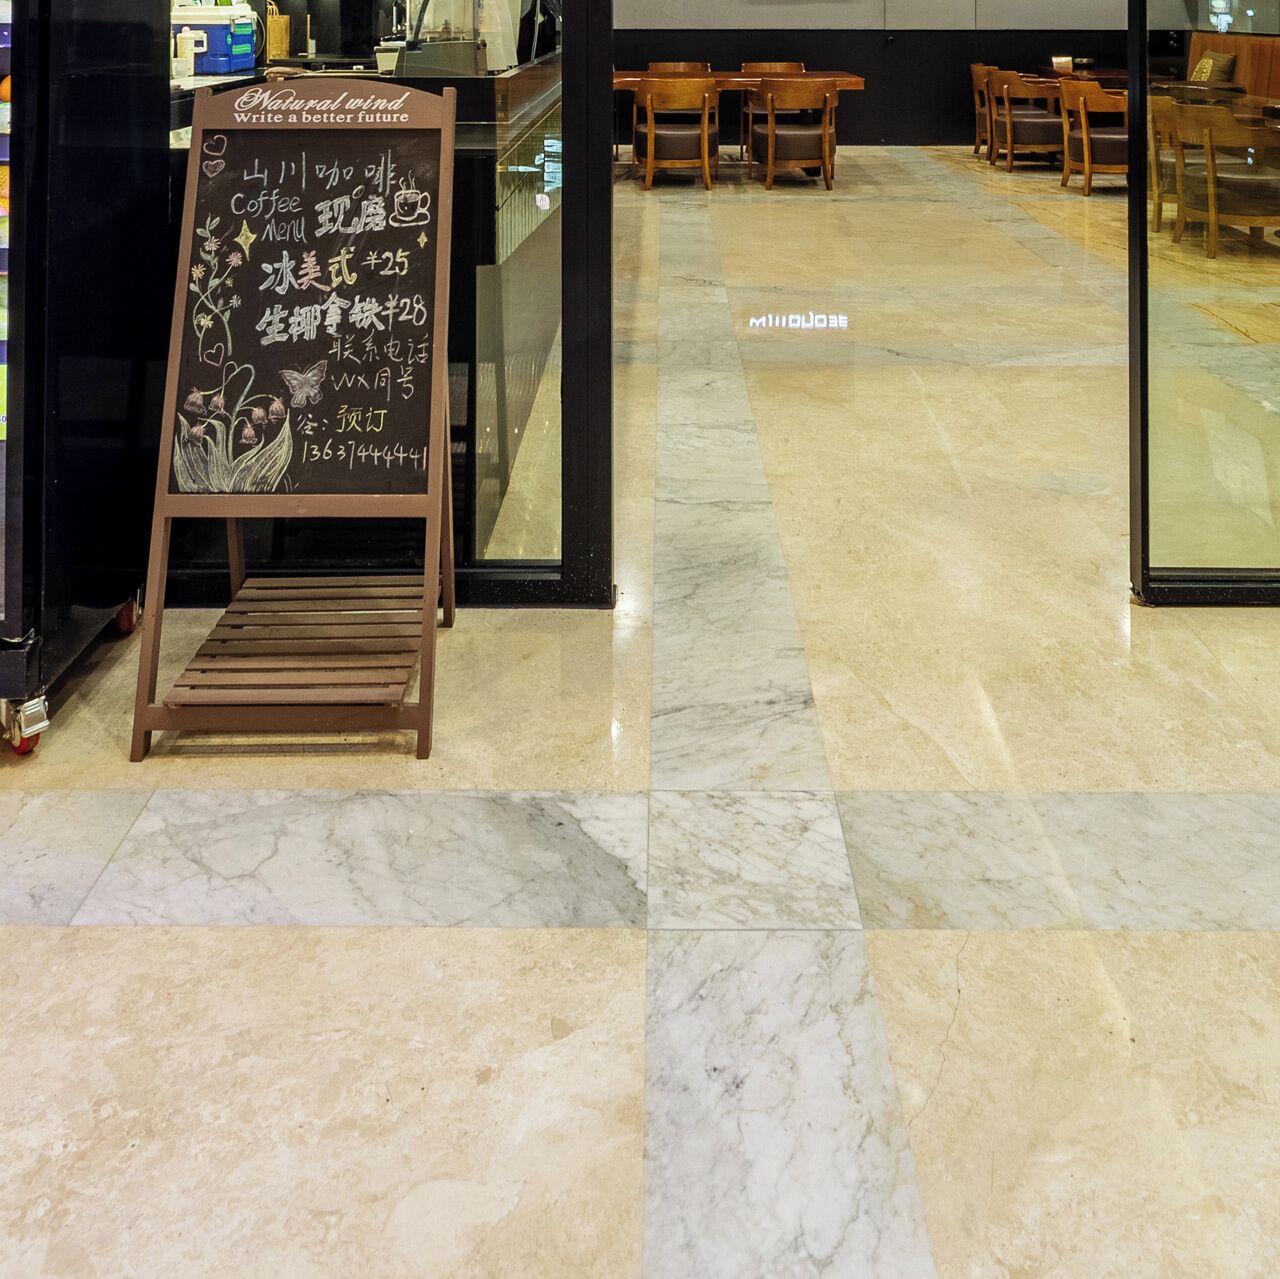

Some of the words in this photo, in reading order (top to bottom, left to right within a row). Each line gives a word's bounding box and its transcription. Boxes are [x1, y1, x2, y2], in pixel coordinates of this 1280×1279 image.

[233, 111, 283, 123] Write
[288, 114, 298, 123] a
[302, 111, 353, 123] better
[357, 111, 409, 123] future
[234, 87, 349, 111] Natural
[345, 92, 411, 111] wind
[243, 149, 397, 197] 山川咖啡
[230, 188, 303, 219] Coffee
[314, 194, 388, 238] 现磨
[258, 246, 358, 295] 冰美式
[255, 291, 385, 346] 生椰拿铁
[328, 328, 429, 365] 联系电话
